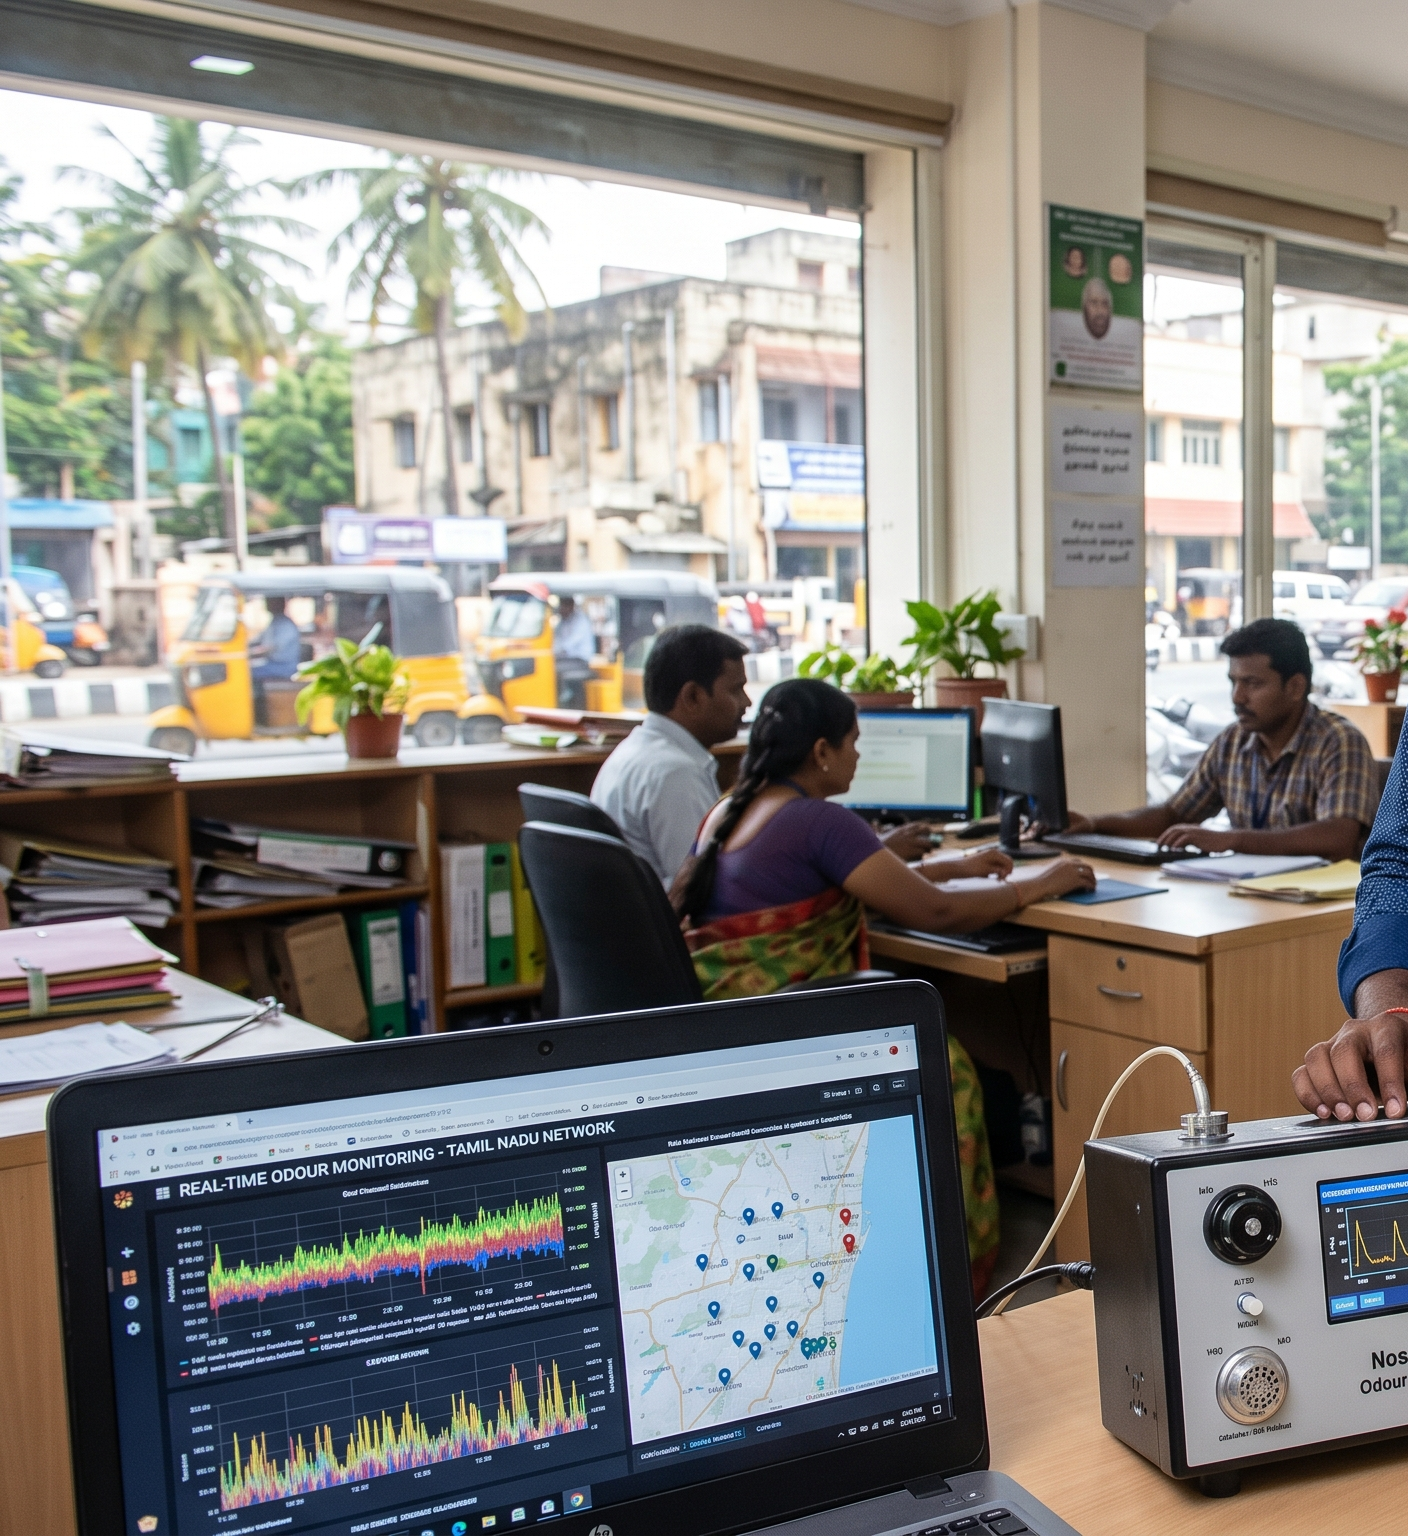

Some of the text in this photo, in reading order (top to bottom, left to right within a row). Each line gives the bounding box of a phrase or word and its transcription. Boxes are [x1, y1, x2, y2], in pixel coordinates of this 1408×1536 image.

[179, 1171, 268, 1198] REAL-TIME
[271, 1162, 330, 1184] ODOUR
[332, 1147, 435, 1175] MONITORING
[446, 1138, 494, 1158] TAMIL
[497, 1130, 540, 1151] NADU
[542, 1120, 616, 1143] NETWORK
[1359, 1374, 1408, 1395] Odour
